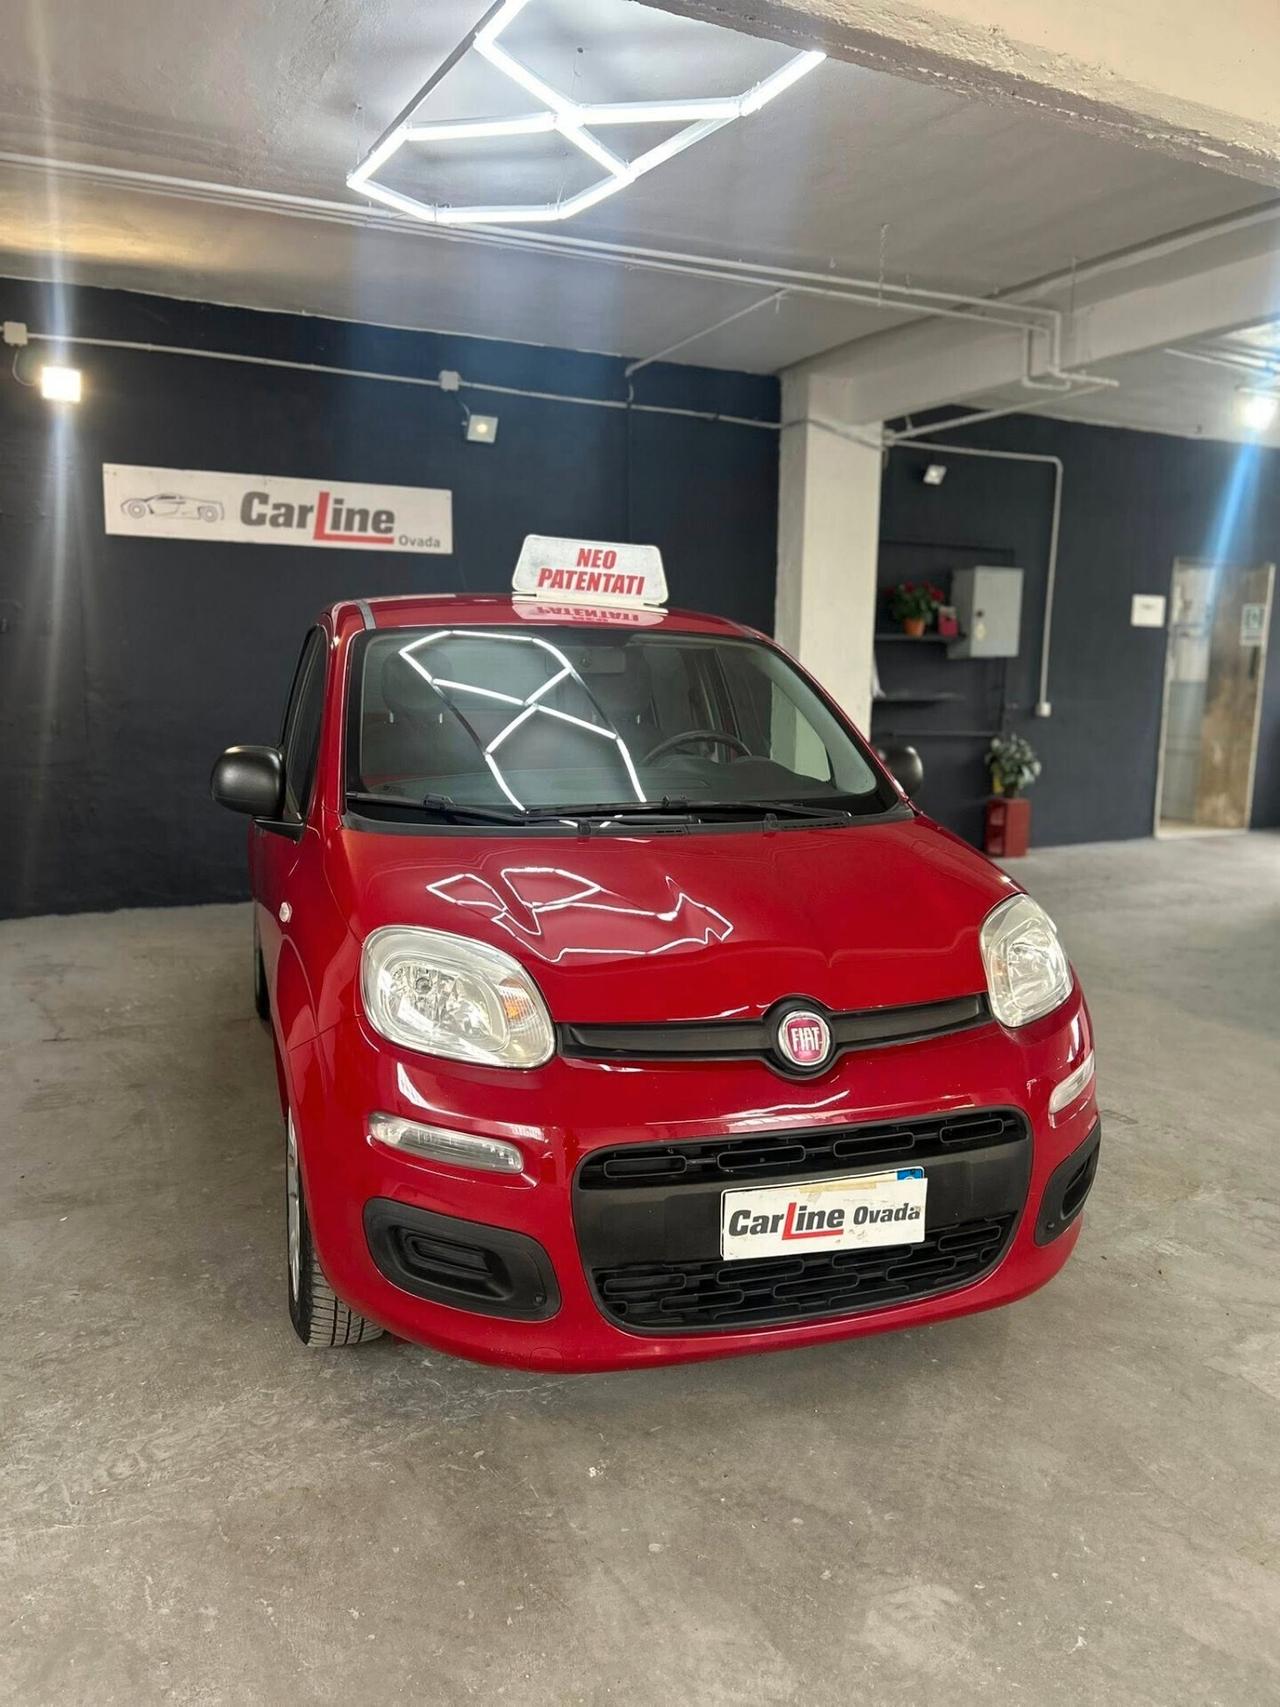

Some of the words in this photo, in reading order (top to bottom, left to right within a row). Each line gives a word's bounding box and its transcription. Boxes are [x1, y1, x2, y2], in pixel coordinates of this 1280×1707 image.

[240, 491, 395, 544] CarLine
[399, 535, 441, 549] Ovada
[577, 548, 617, 569] NEO
[537, 568, 645, 595] PATENTATI
[791, 1027, 820, 1052] FIAT
[729, 1202, 845, 1240] CarLine
[853, 1203, 921, 1225] Ovada
